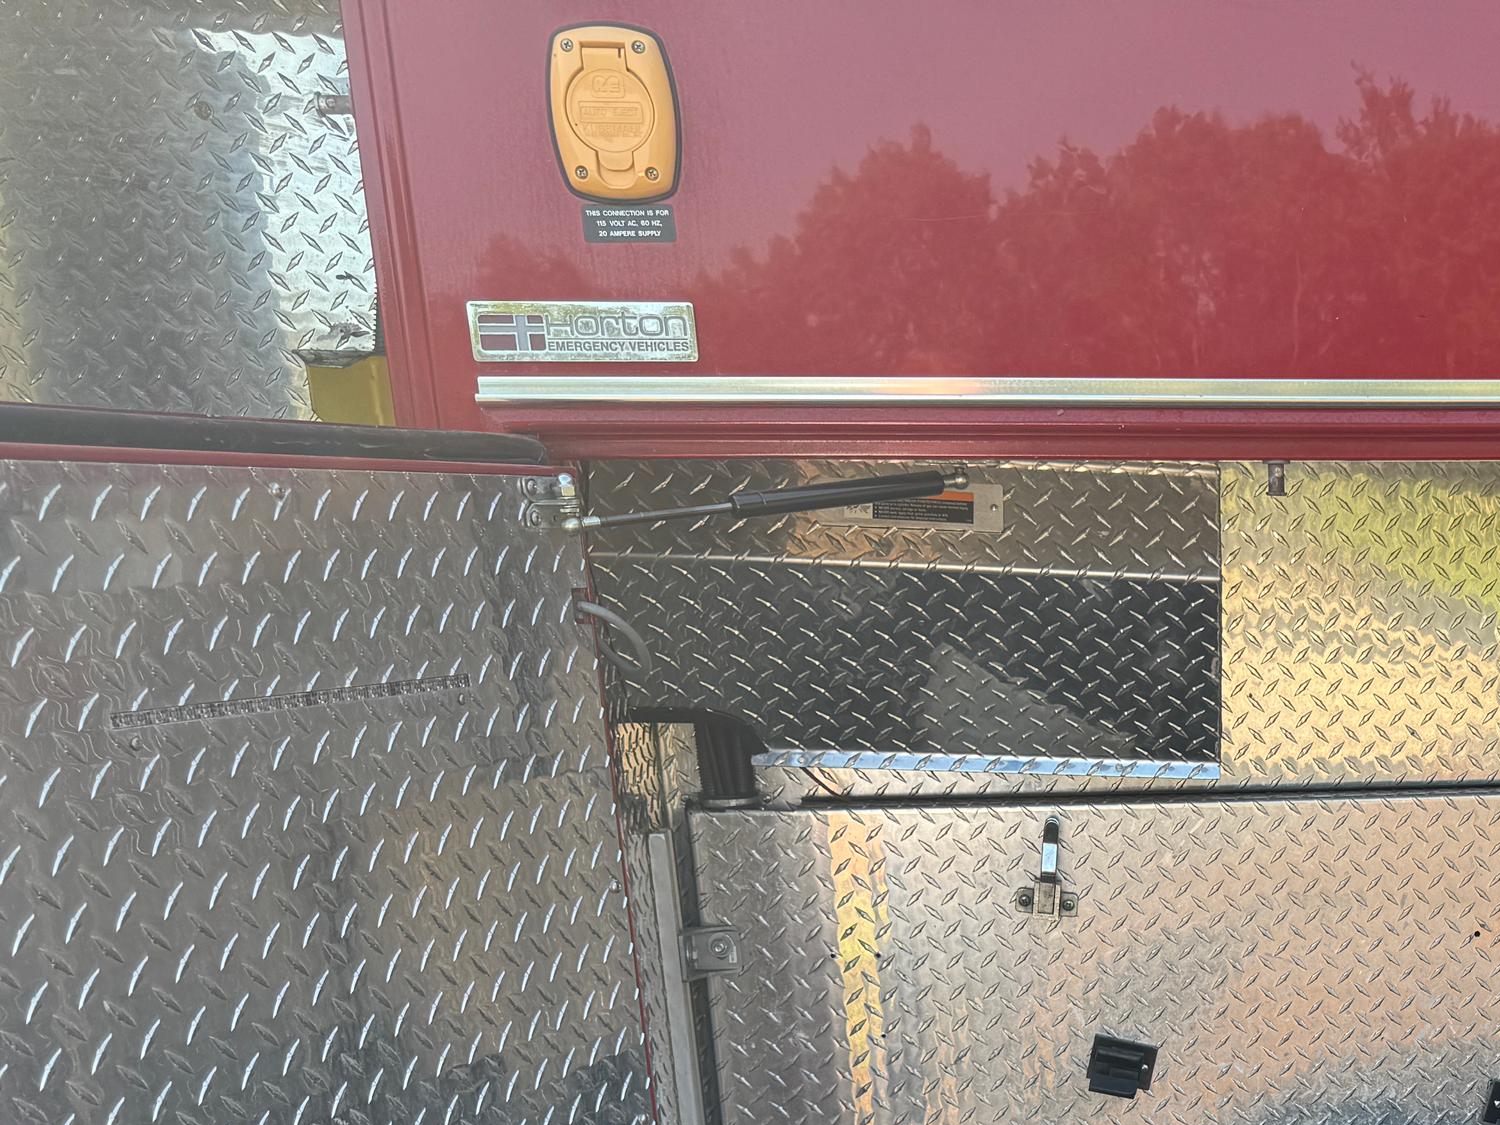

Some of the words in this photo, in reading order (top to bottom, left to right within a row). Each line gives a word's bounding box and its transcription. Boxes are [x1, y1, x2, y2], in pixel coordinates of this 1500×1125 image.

[602, 209, 645, 217] CONNECTION
[547, 340, 626, 352] EMERGENCY
[628, 340, 690, 352] VEHICLES
